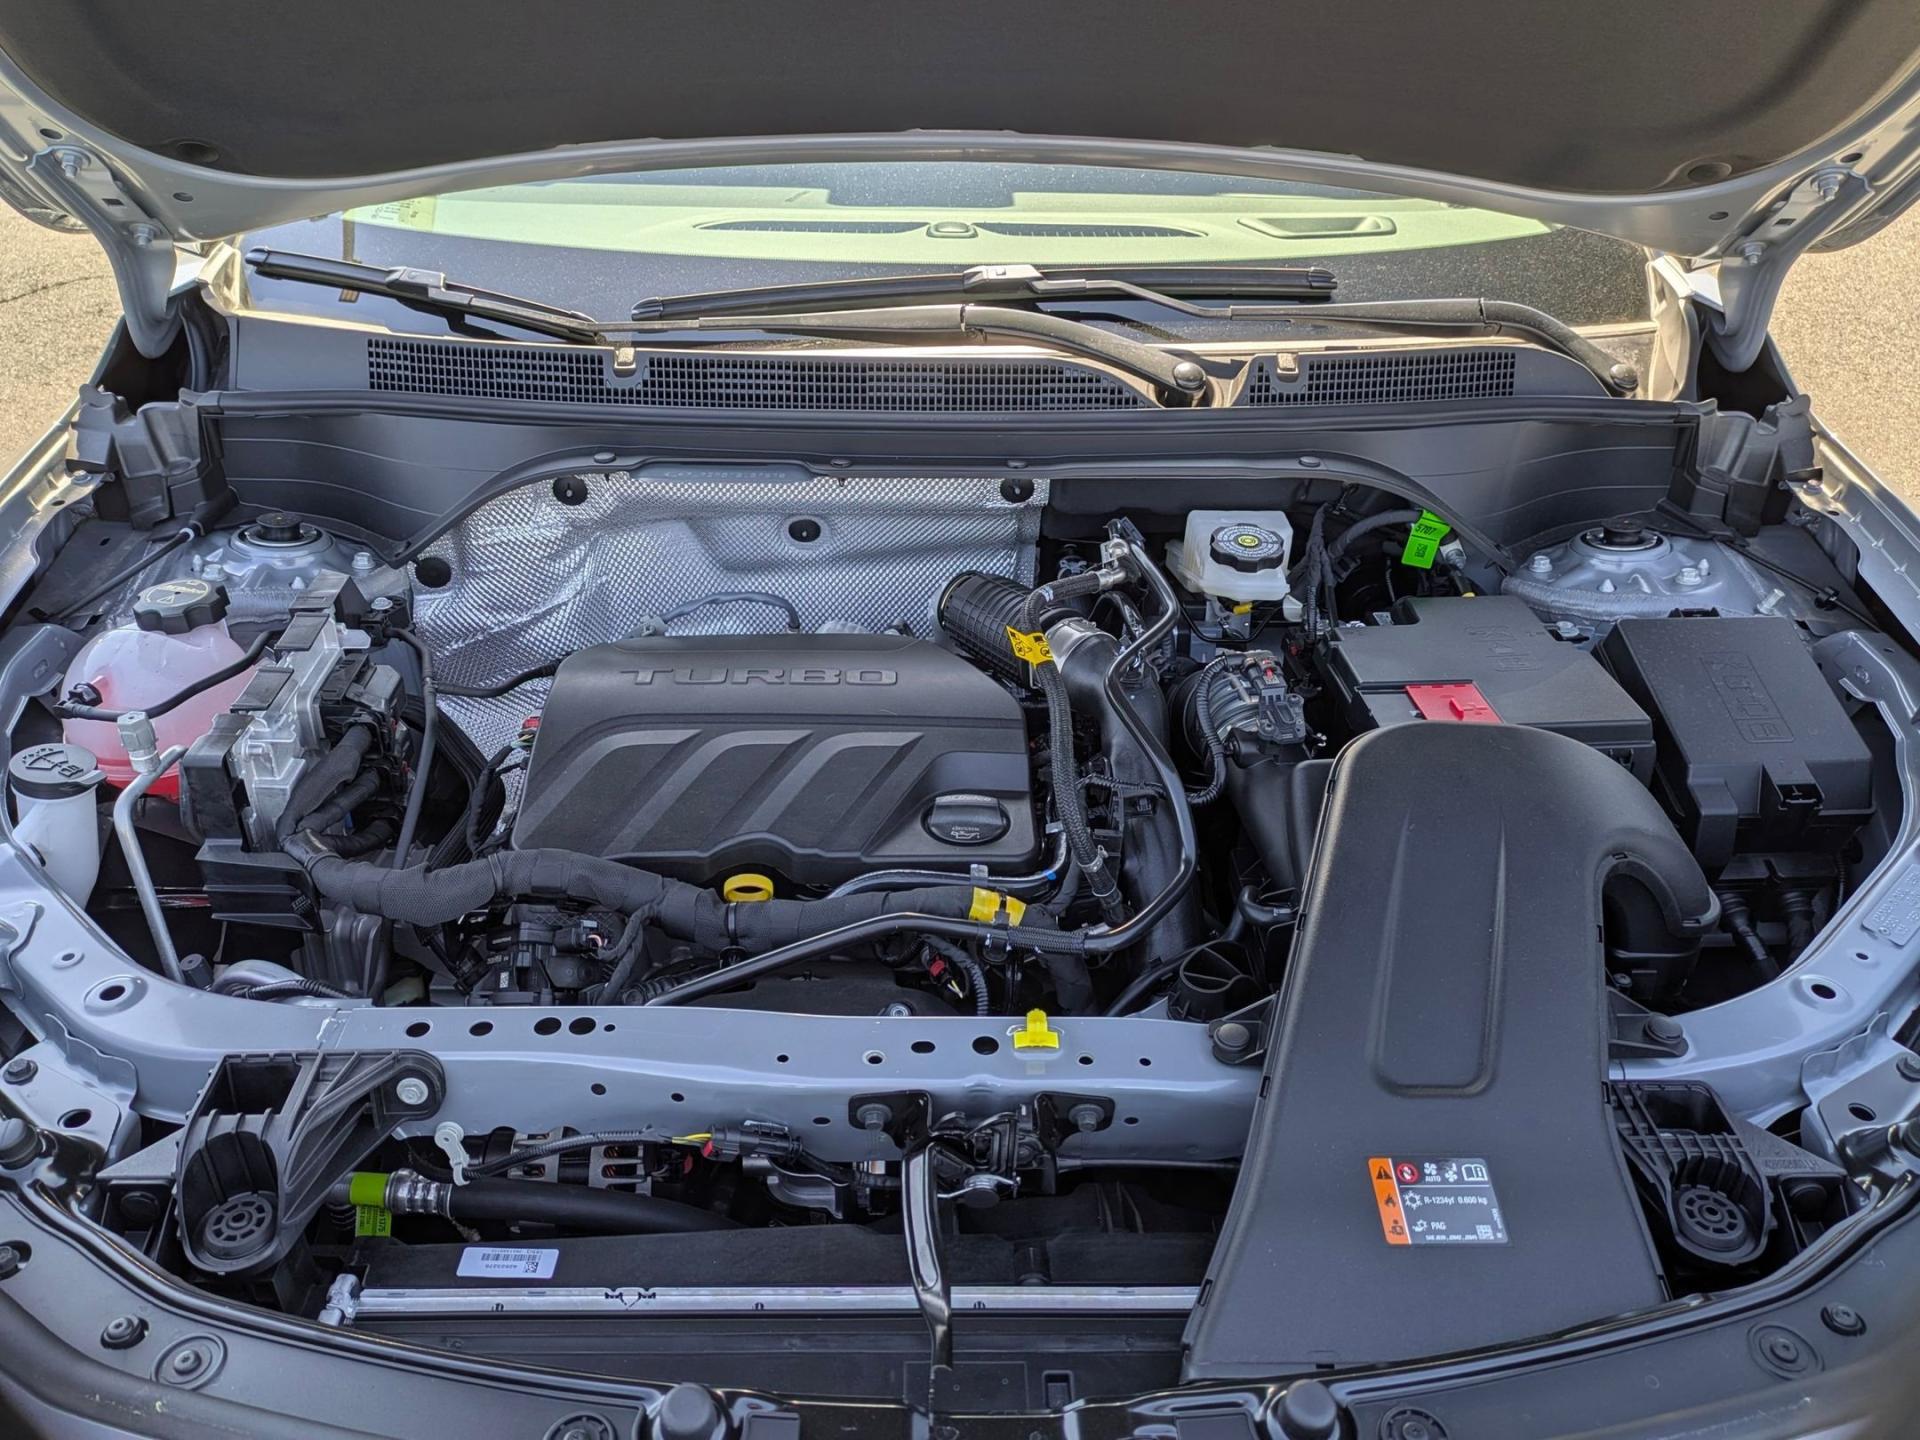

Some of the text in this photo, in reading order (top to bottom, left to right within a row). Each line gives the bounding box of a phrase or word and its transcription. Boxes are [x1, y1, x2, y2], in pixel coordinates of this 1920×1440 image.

[620, 668, 898, 686] TURBO
[1424, 1196, 1454, 1206] R-1234yf
[1478, 1196, 1488, 1205] kg
[1430, 1222, 1446, 1230] PAG
